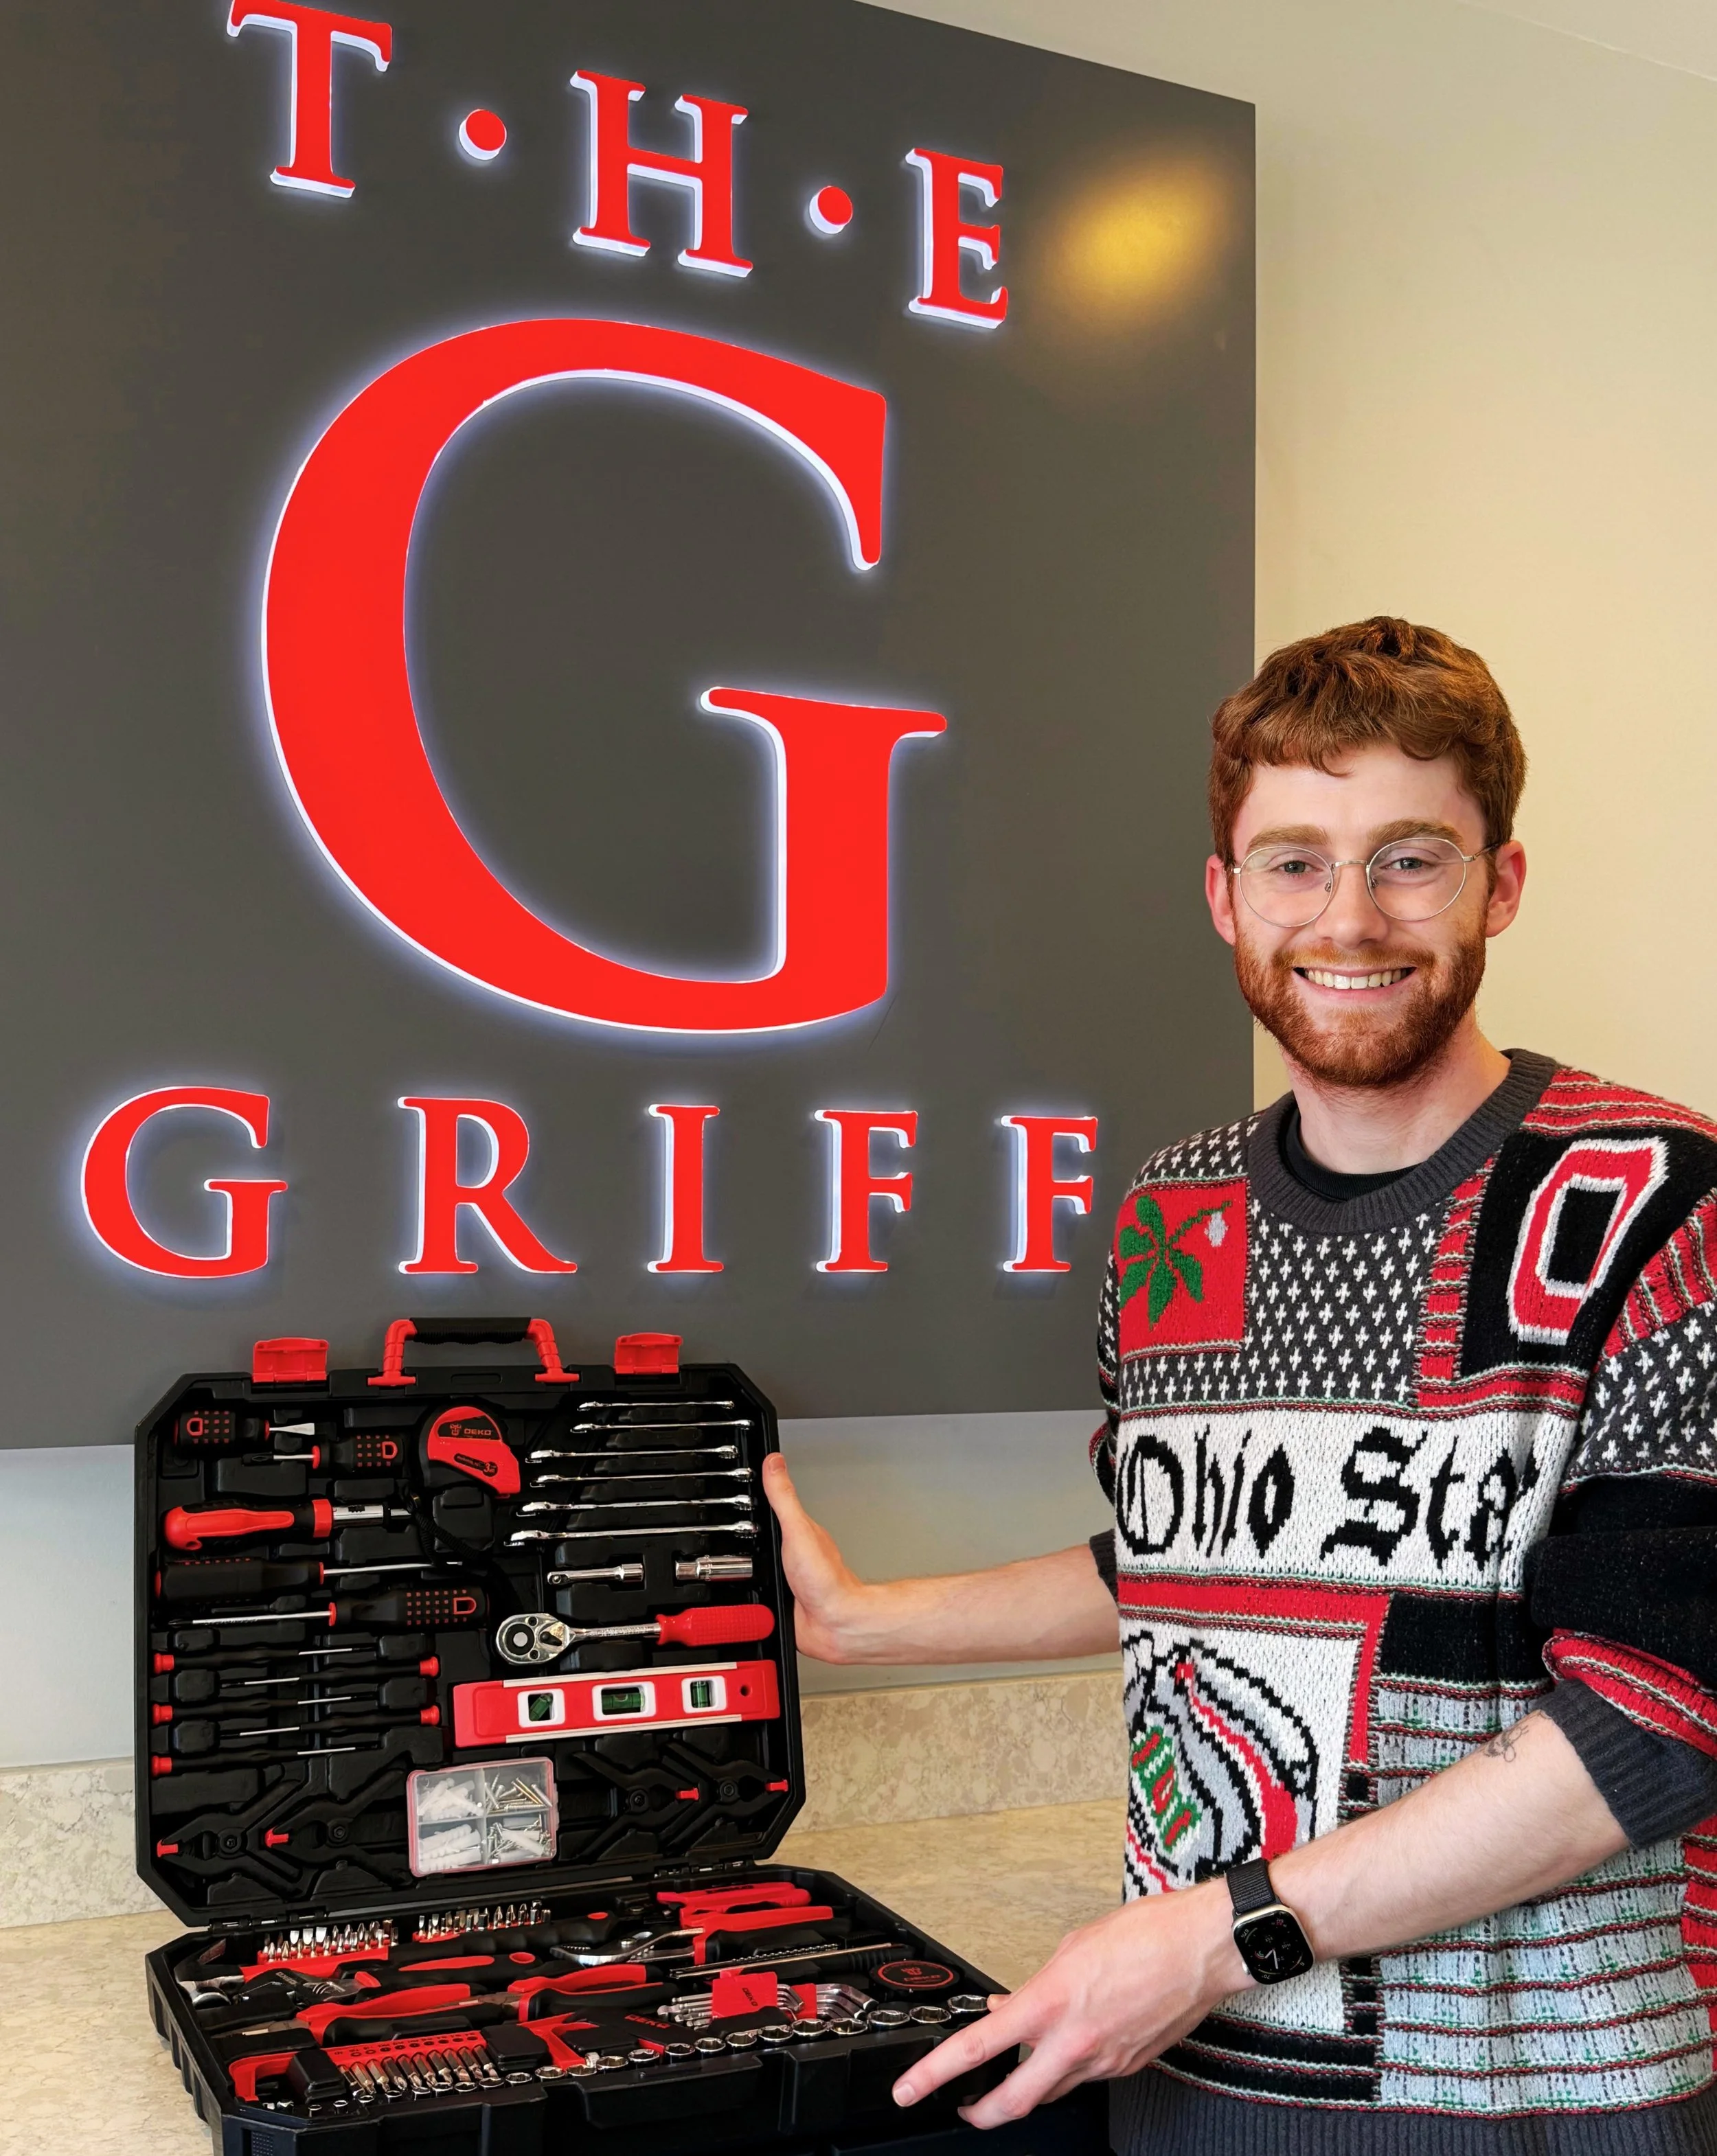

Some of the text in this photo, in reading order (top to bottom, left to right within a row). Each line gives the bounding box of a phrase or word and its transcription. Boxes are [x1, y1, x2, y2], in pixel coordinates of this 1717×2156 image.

[262, 318, 946, 1035] G
[80, 1086, 1098, 1277] GRIFF
[1116, 1423, 1295, 1557] Ohio
[624, 2013, 670, 2029] DEKO
[742, 1988, 758, 2006] DEKO
